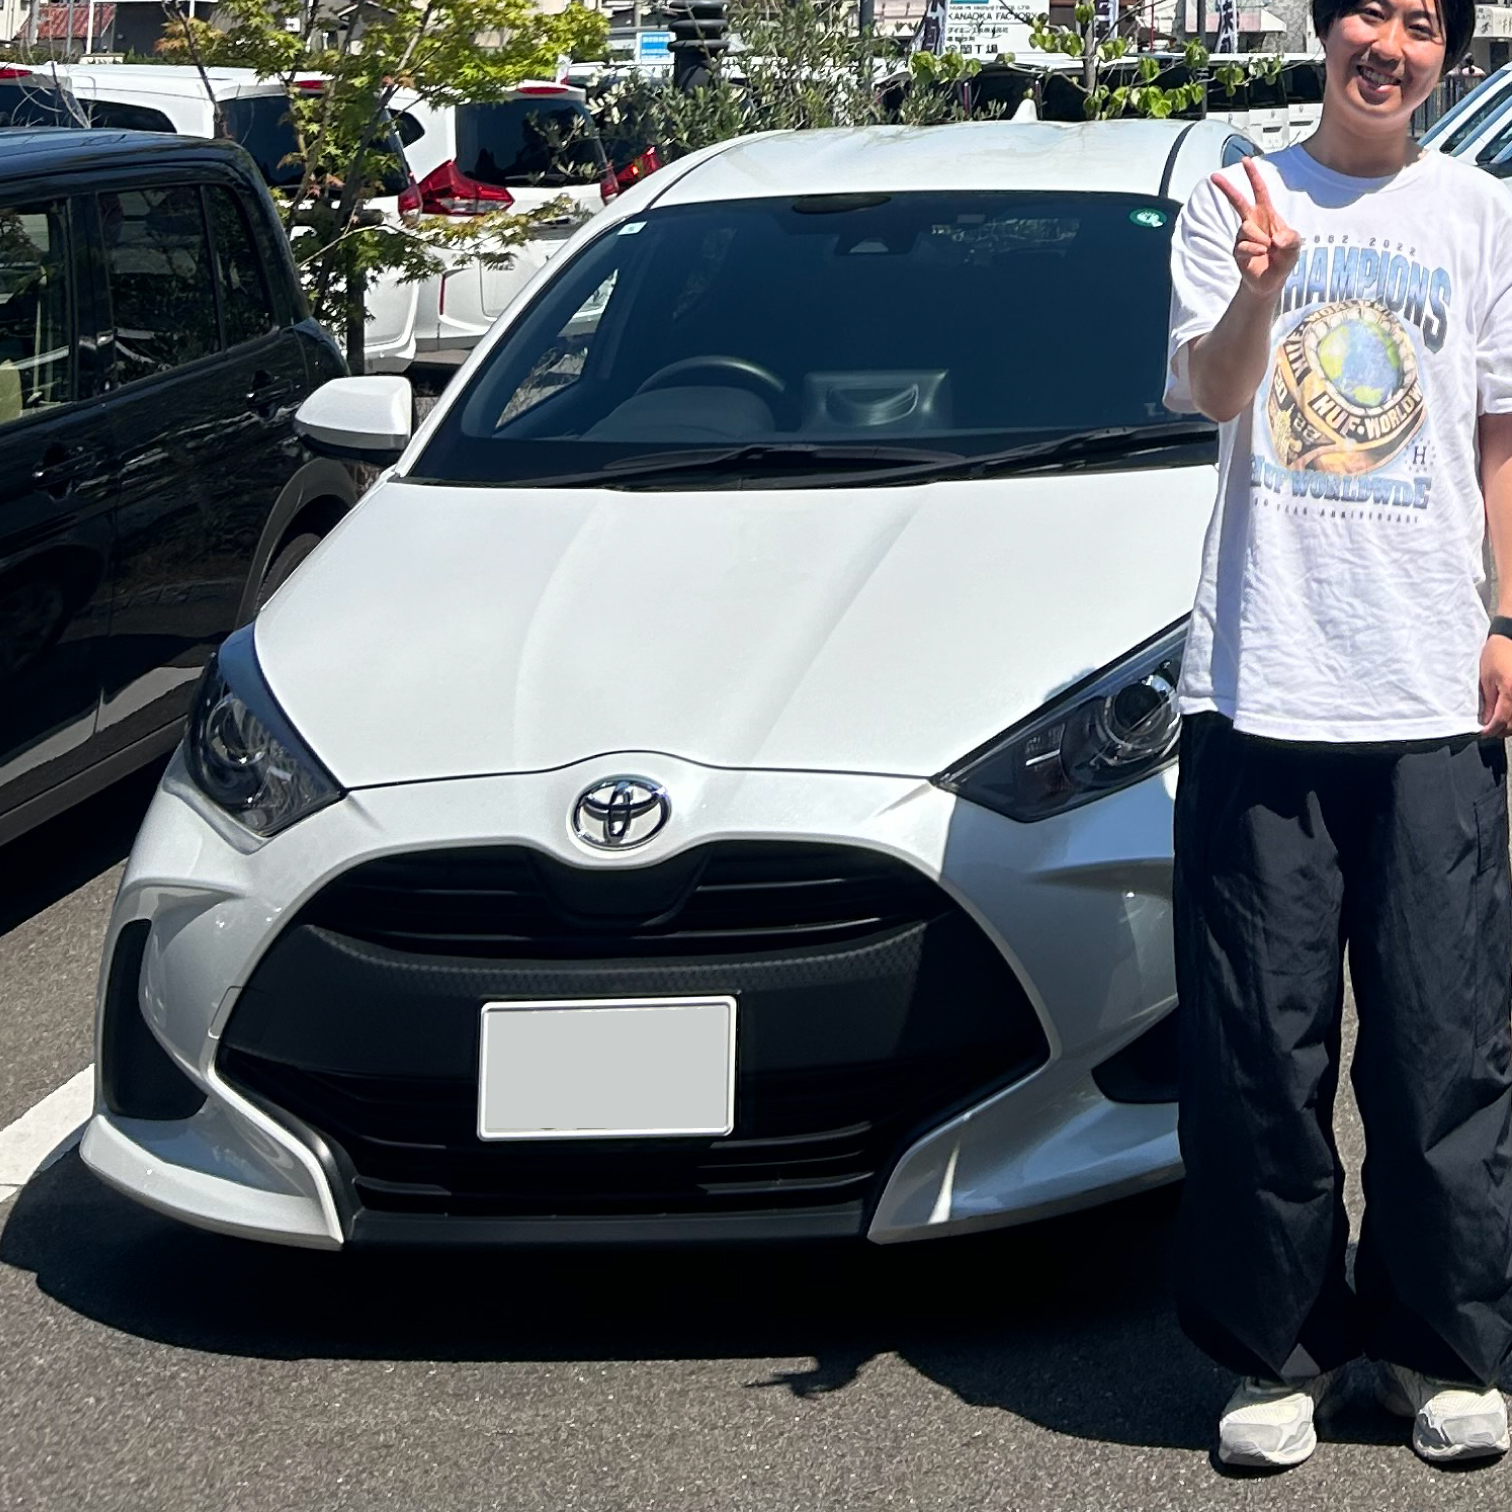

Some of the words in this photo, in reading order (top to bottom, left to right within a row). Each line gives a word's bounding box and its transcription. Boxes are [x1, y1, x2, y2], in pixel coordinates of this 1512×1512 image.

[948, 12, 992, 20] KANAOKA
[1276, 246, 1451, 354] HAMPIONS
[1292, 470, 1432, 509] WORLDWIDE
